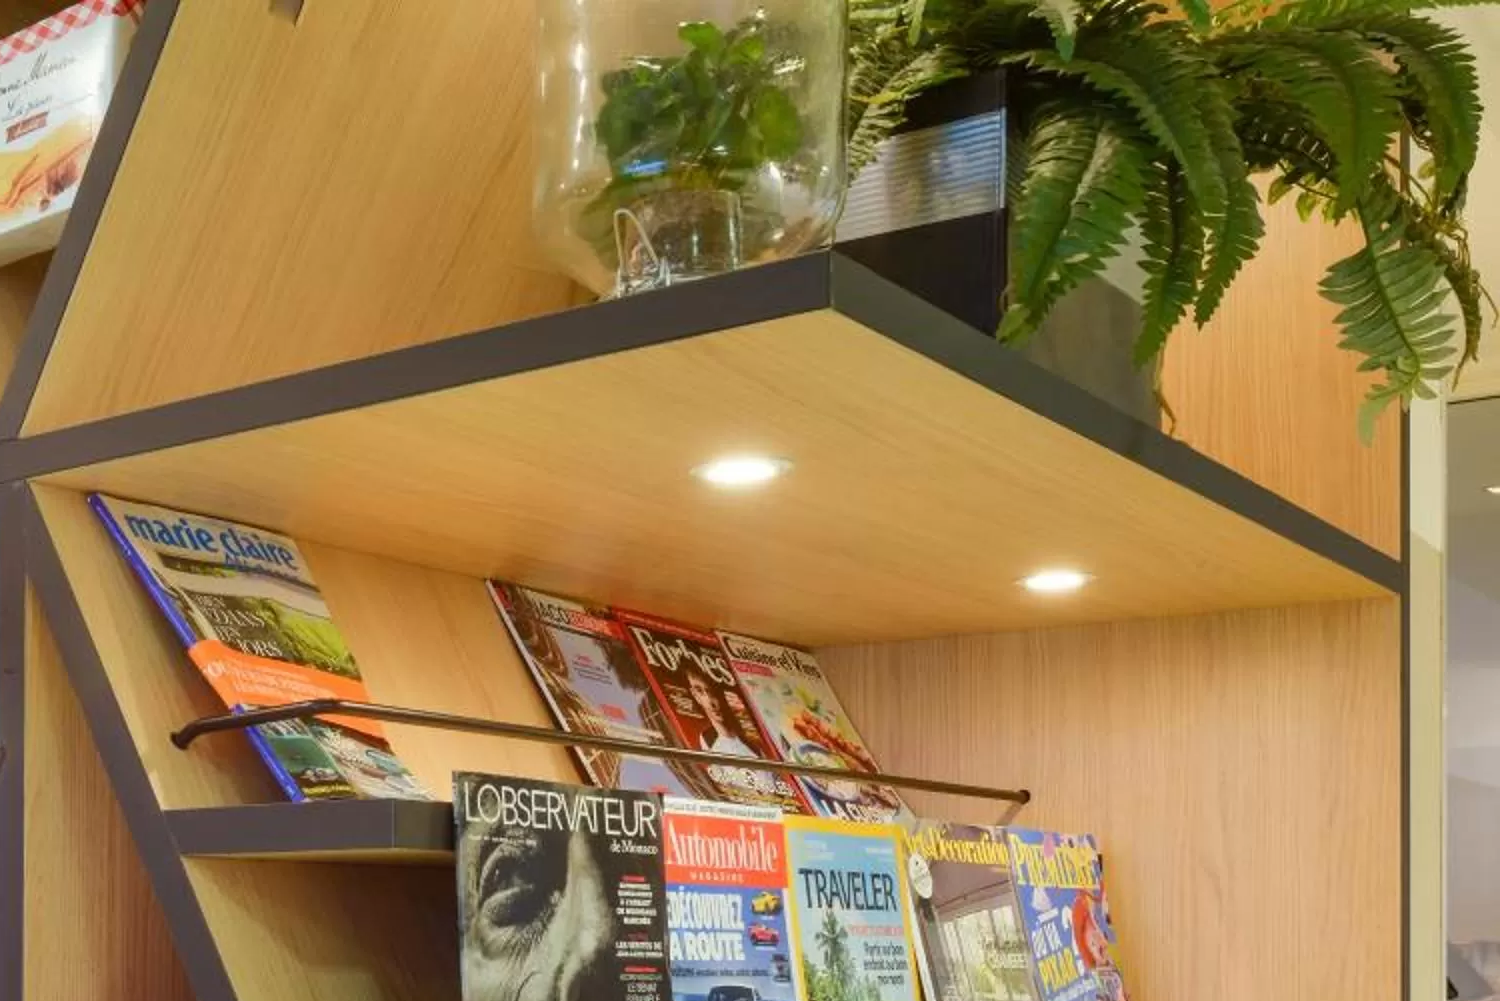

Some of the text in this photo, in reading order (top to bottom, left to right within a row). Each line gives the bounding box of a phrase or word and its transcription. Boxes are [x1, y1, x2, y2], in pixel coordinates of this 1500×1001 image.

[125, 511, 218, 553] marie
[219, 526, 296, 571] claire
[628, 626, 737, 687] Forbes
[666, 819, 778, 873] Automobile
[798, 867, 898, 912] TRAVELER
[687, 931, 746, 961] ROUTE
